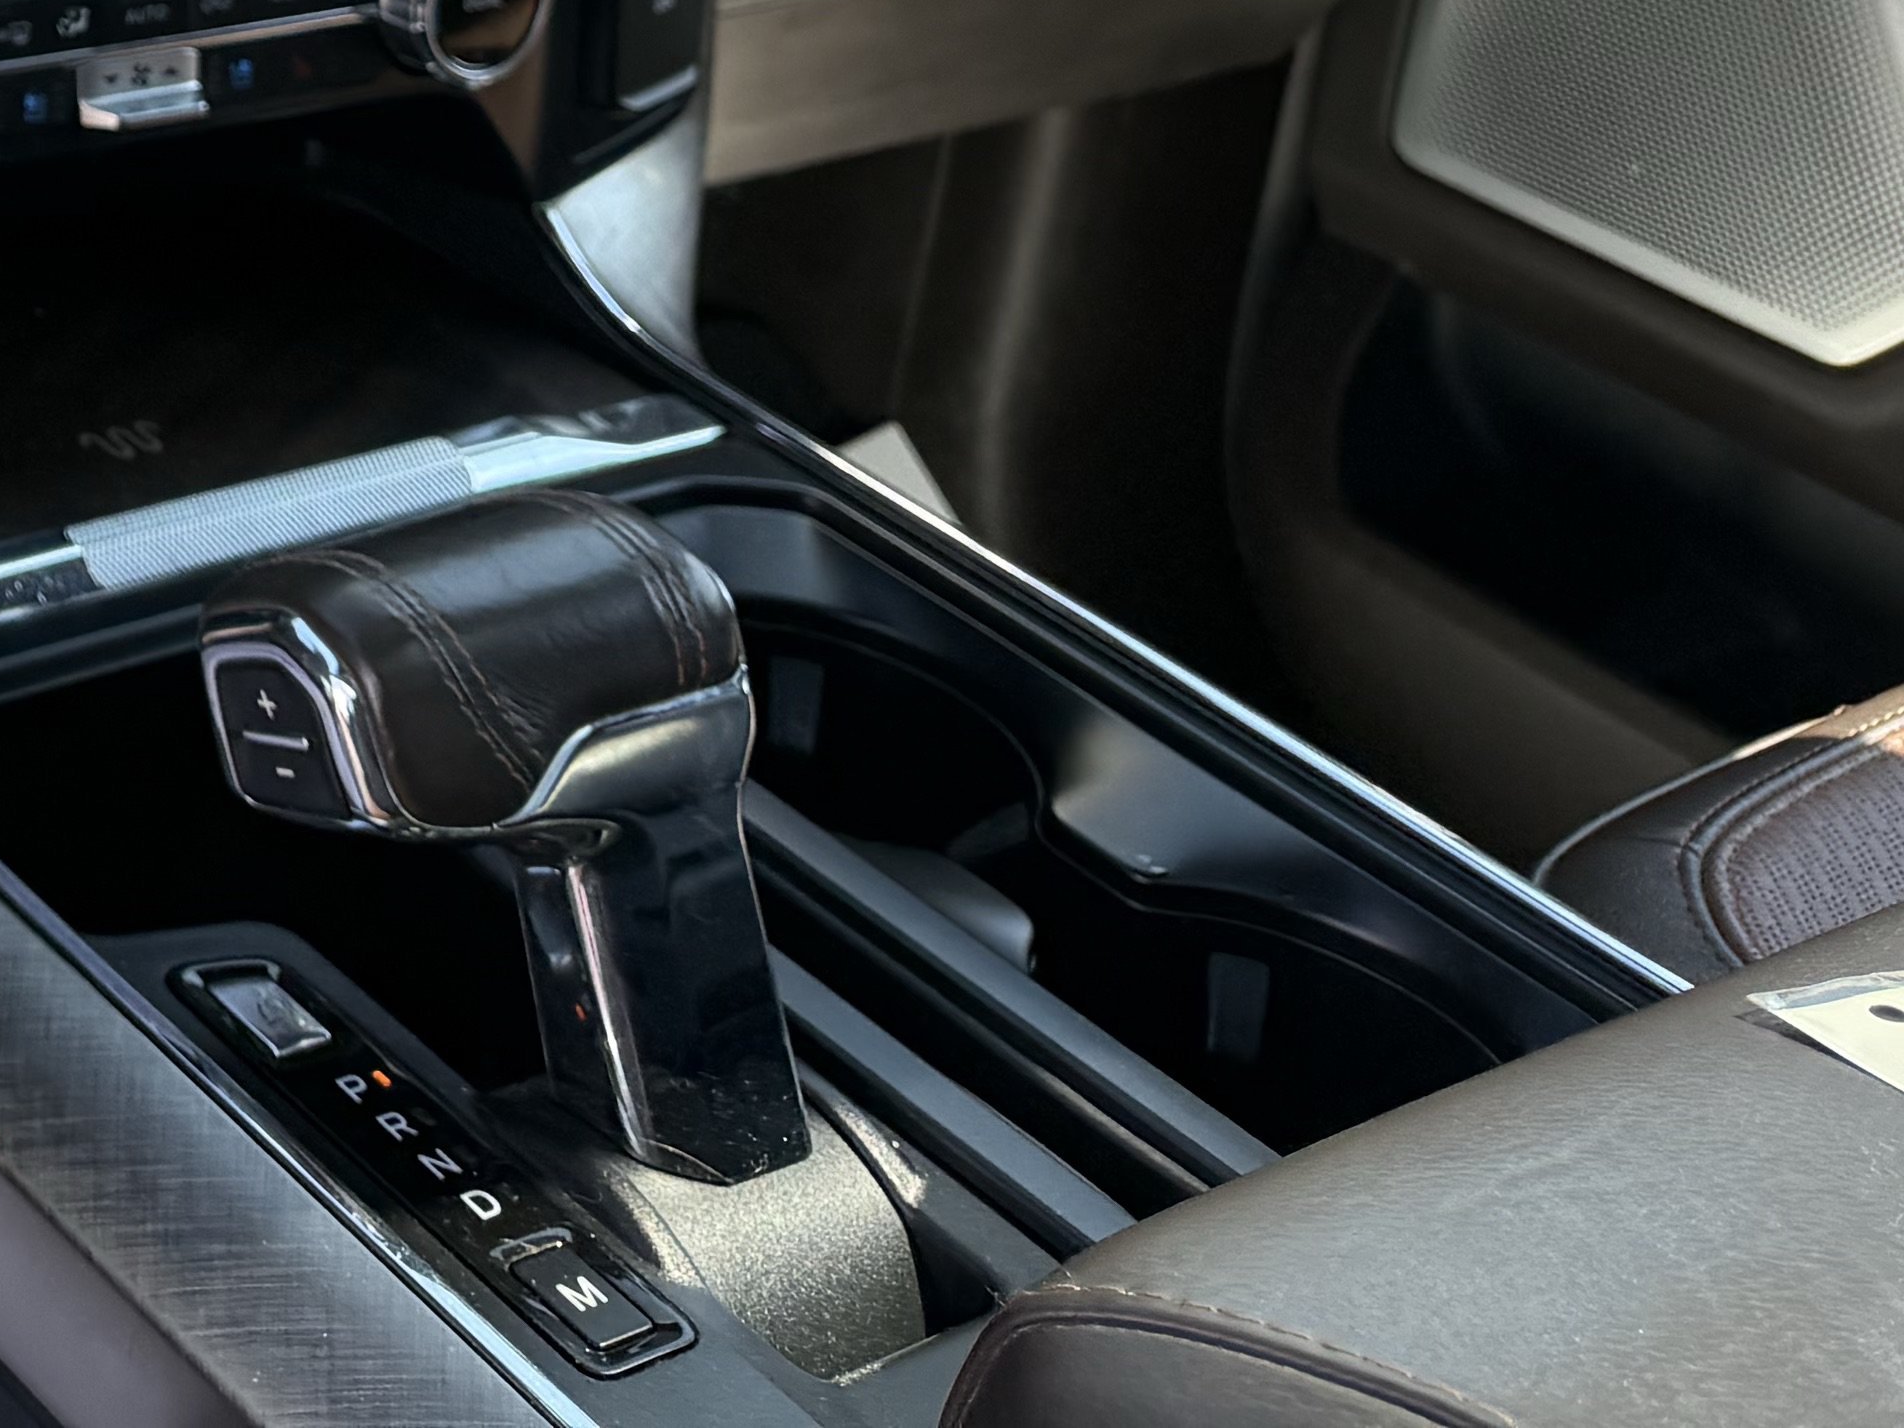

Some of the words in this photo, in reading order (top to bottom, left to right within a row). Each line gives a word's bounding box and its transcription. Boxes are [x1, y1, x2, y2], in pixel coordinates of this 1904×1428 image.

[334, 1074, 367, 1104] P
[375, 1111, 419, 1142] R
[416, 1147, 463, 1180] N
[459, 1189, 502, 1221] D
[555, 1275, 609, 1312] M
